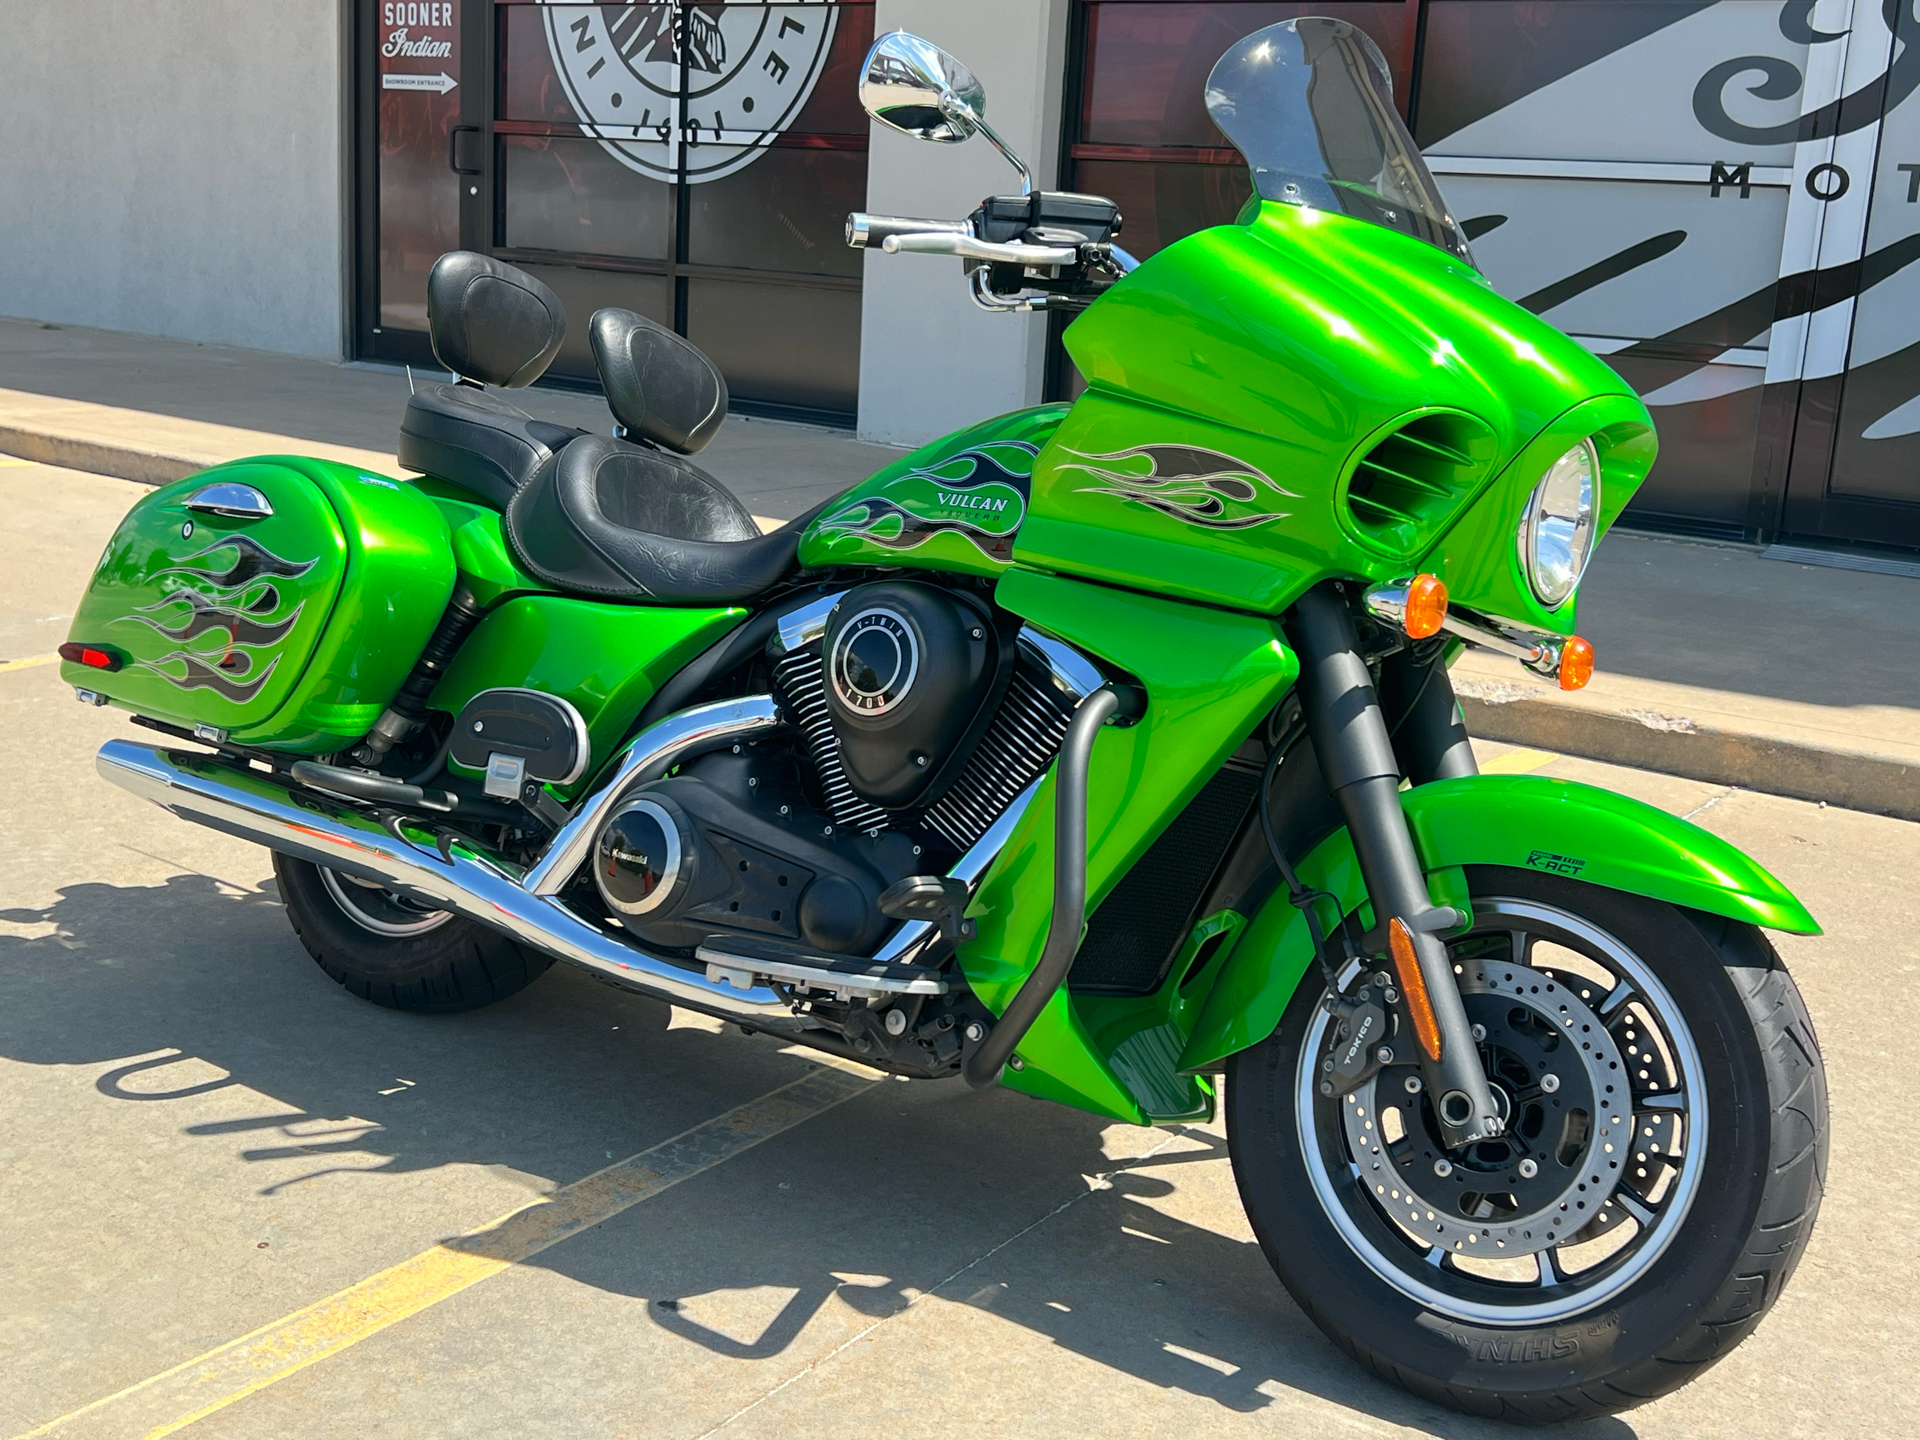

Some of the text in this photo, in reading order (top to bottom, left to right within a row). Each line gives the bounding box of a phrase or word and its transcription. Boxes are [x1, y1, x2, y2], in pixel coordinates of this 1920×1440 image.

[384, 2, 452, 27] SOONER
[381, 27, 452, 58] Indian
[937, 492, 1009, 511] VULCAN
[940, 508, 1000, 522] VAQUERO
[857, 616, 904, 638] V-TWIN
[845, 688, 885, 709] 1700
[1525, 854, 1584, 875] K-ACT
[1343, 1016, 1373, 1065] TOKICO
